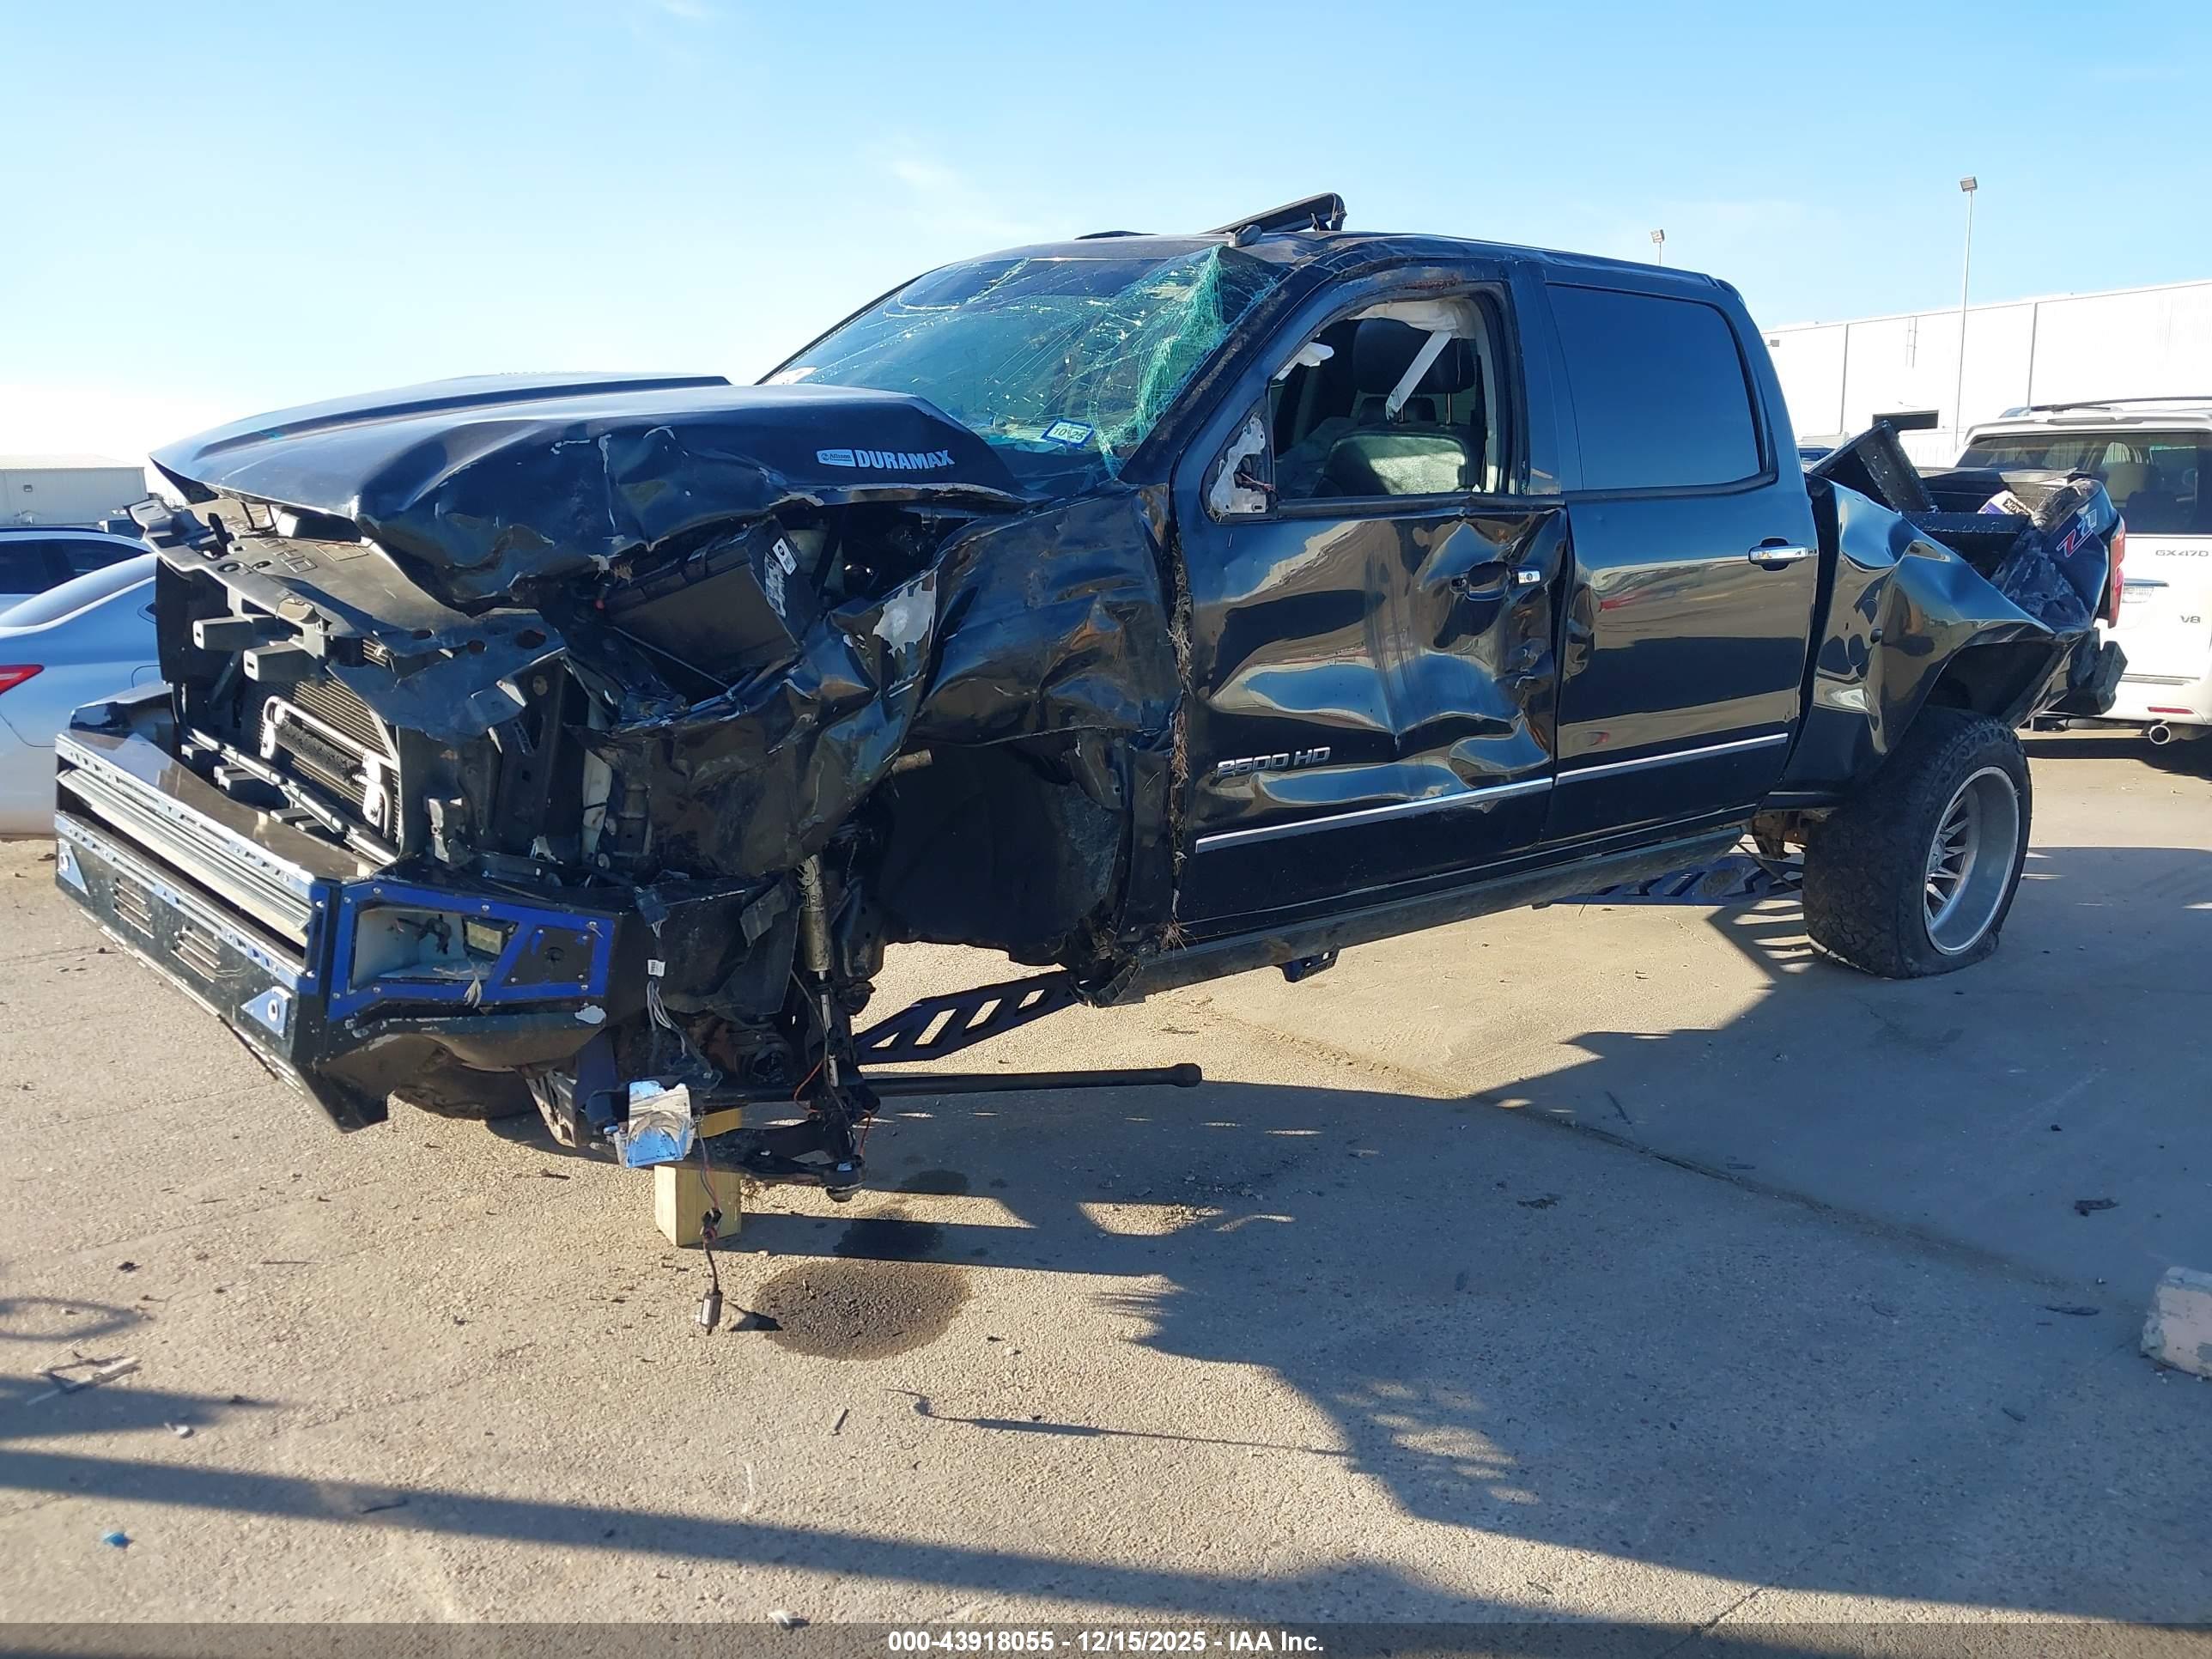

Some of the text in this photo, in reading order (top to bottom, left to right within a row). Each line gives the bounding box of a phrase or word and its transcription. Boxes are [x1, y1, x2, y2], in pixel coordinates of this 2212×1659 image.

[1053, 428, 1067, 436] 10
[854, 449, 956, 470] DURAMAX
[2056, 508, 2097, 558] Z71
[2180, 615, 2201, 623] V8
[1216, 746, 1331, 778] 2500 HD
